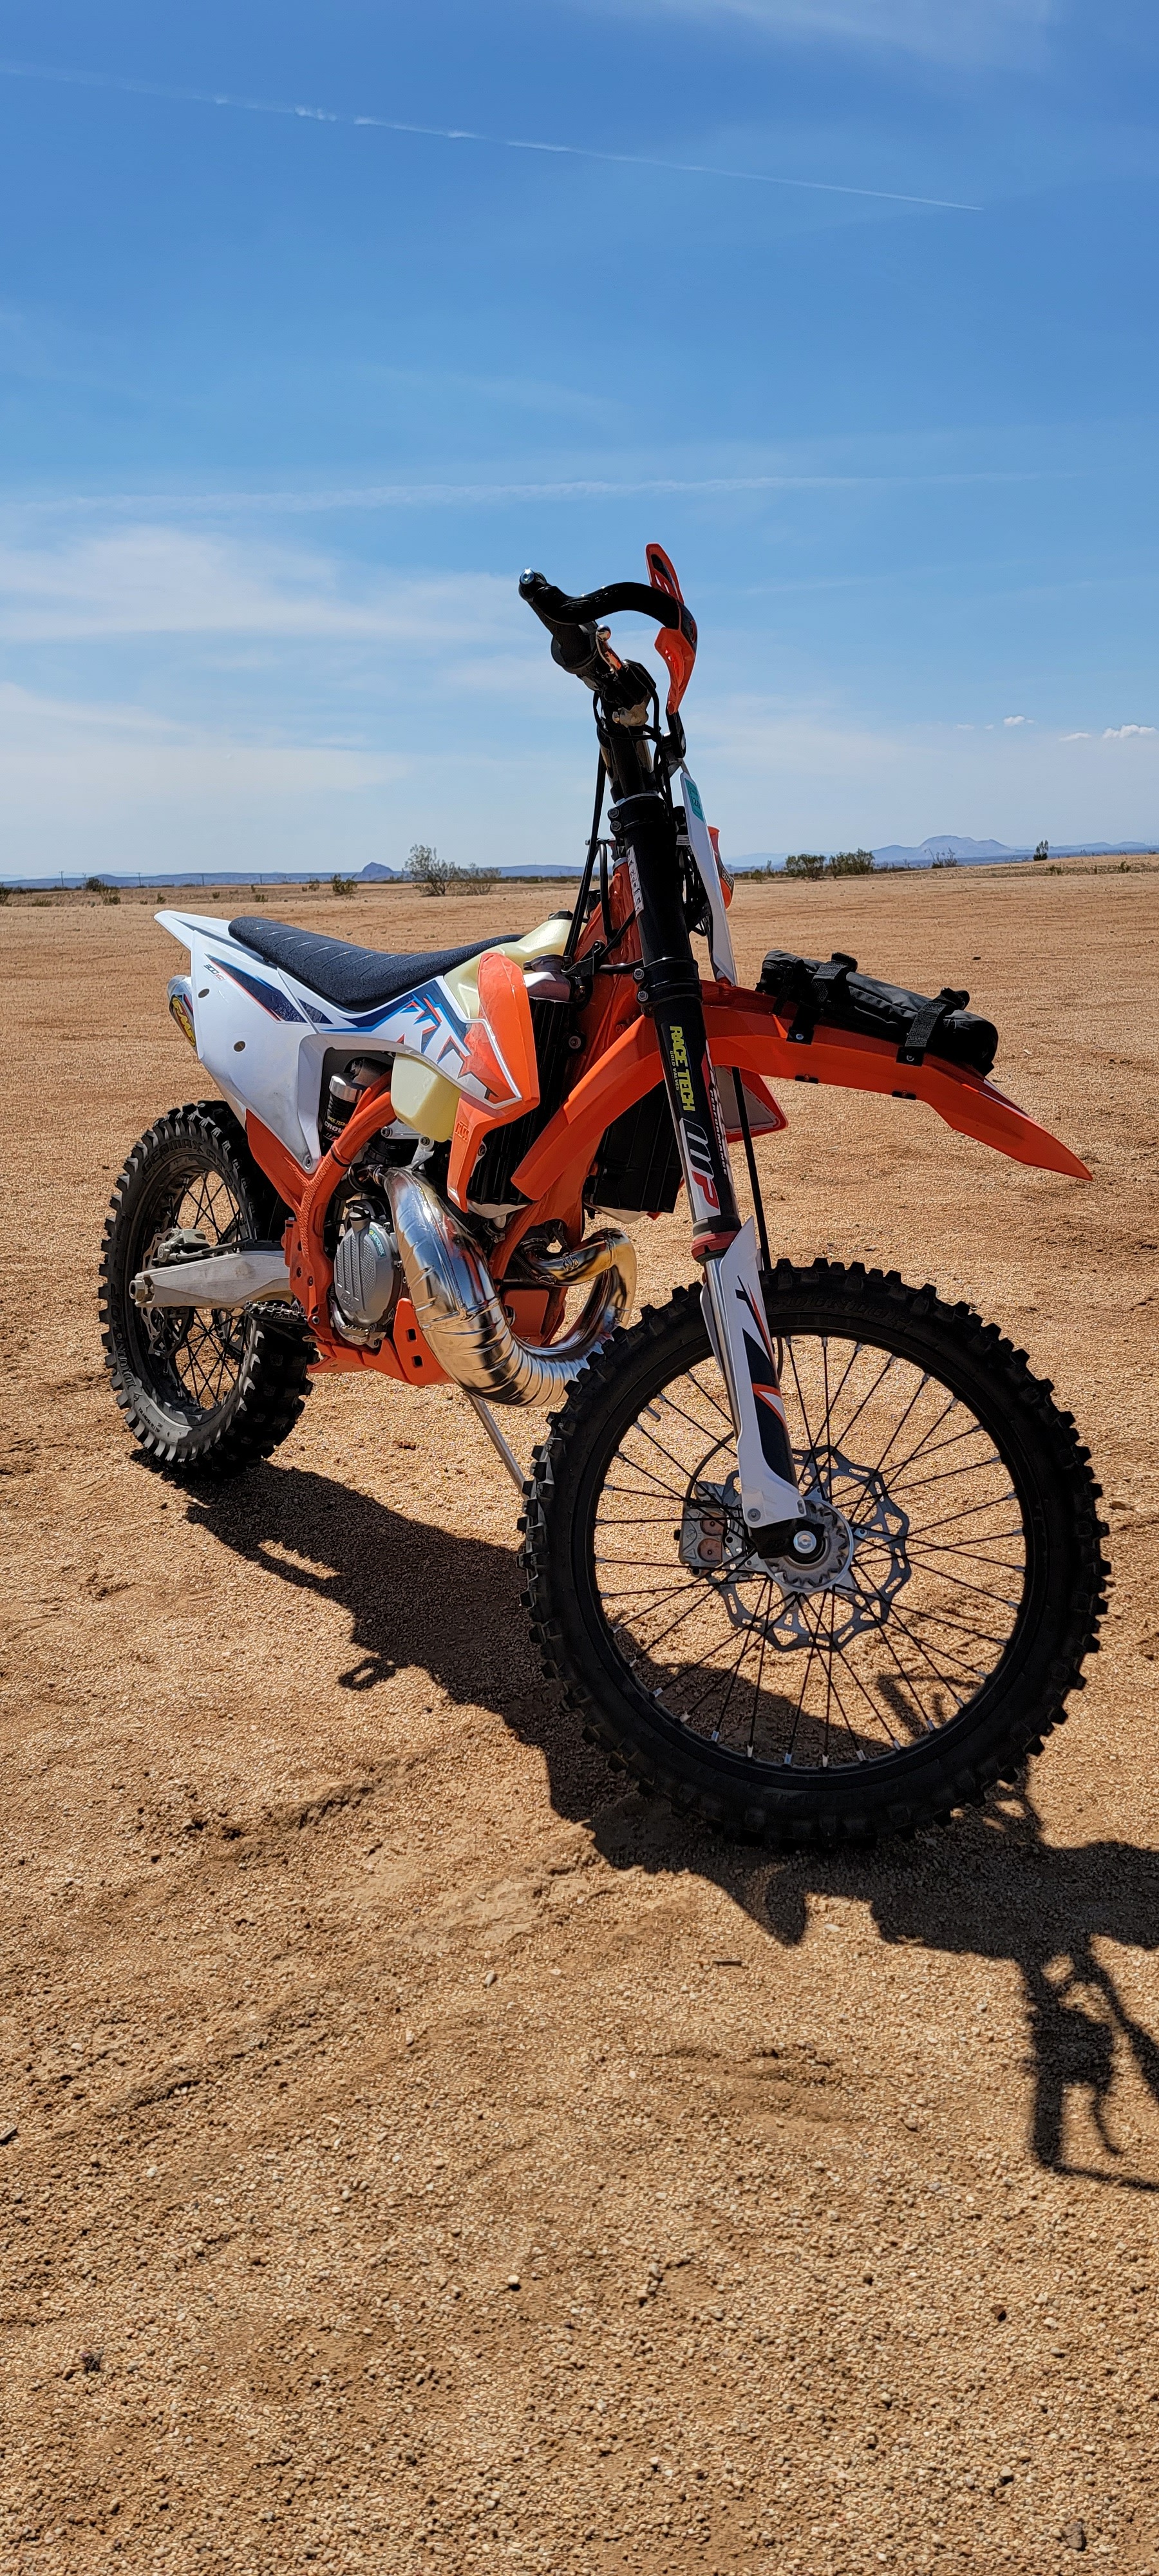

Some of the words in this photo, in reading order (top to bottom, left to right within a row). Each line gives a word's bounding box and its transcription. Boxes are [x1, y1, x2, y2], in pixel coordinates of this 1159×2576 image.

[172, 999, 196, 1043] FMF
[670, 1025, 688, 1066] RACE
[677, 1068, 695, 1111] TECH
[710, 1090, 728, 1175] PERFORMANCE
[372, 1233, 385, 1256] MOTOREX
[785, 1296, 913, 1327] DUNLOP
